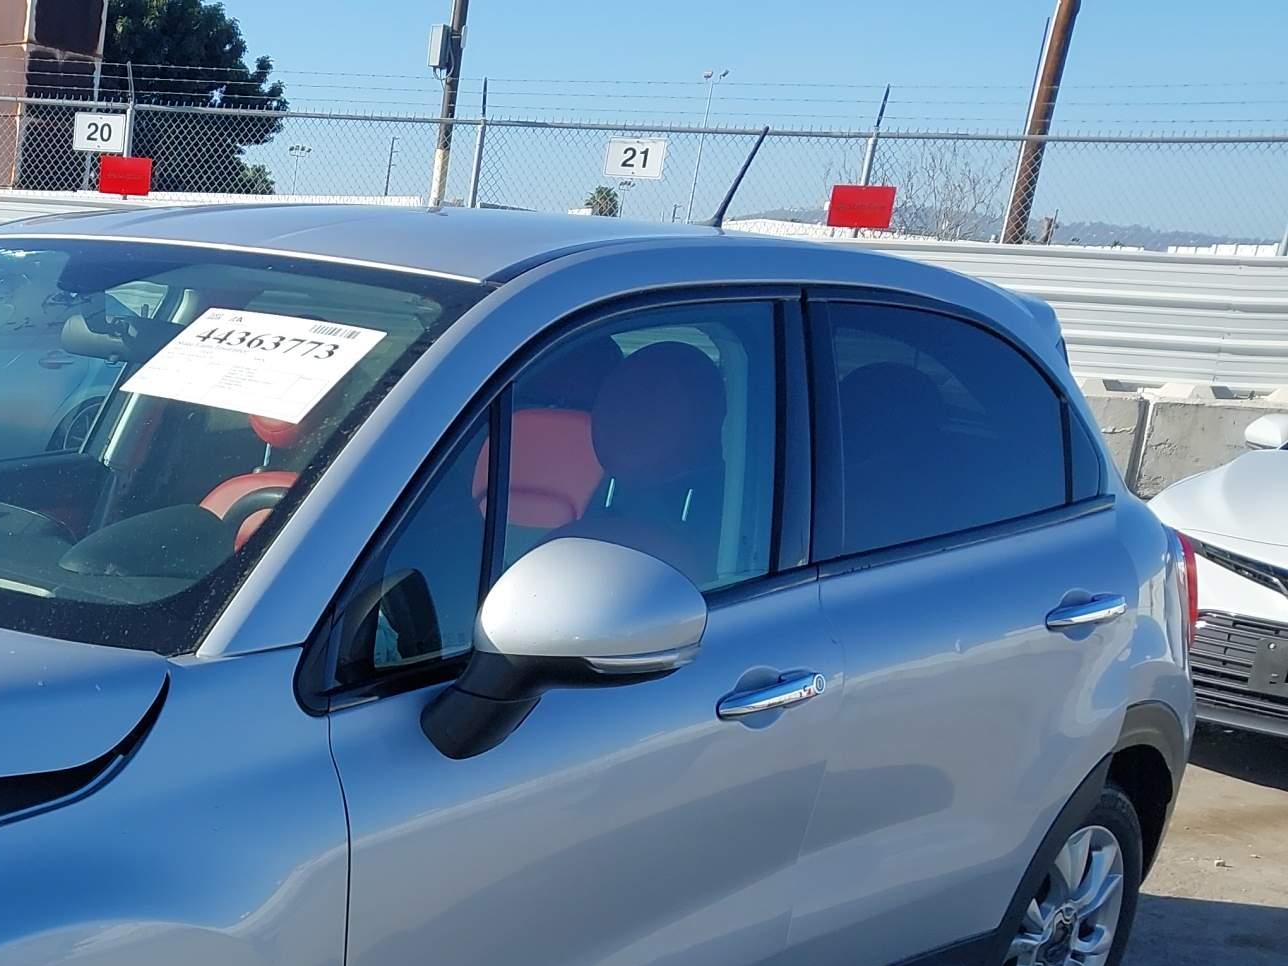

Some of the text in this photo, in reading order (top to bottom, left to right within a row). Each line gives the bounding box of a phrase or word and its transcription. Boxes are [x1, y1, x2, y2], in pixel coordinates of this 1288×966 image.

[86, 122, 113, 142] 20
[620, 147, 650, 169] 21
[195, 327, 341, 360] 44363773
